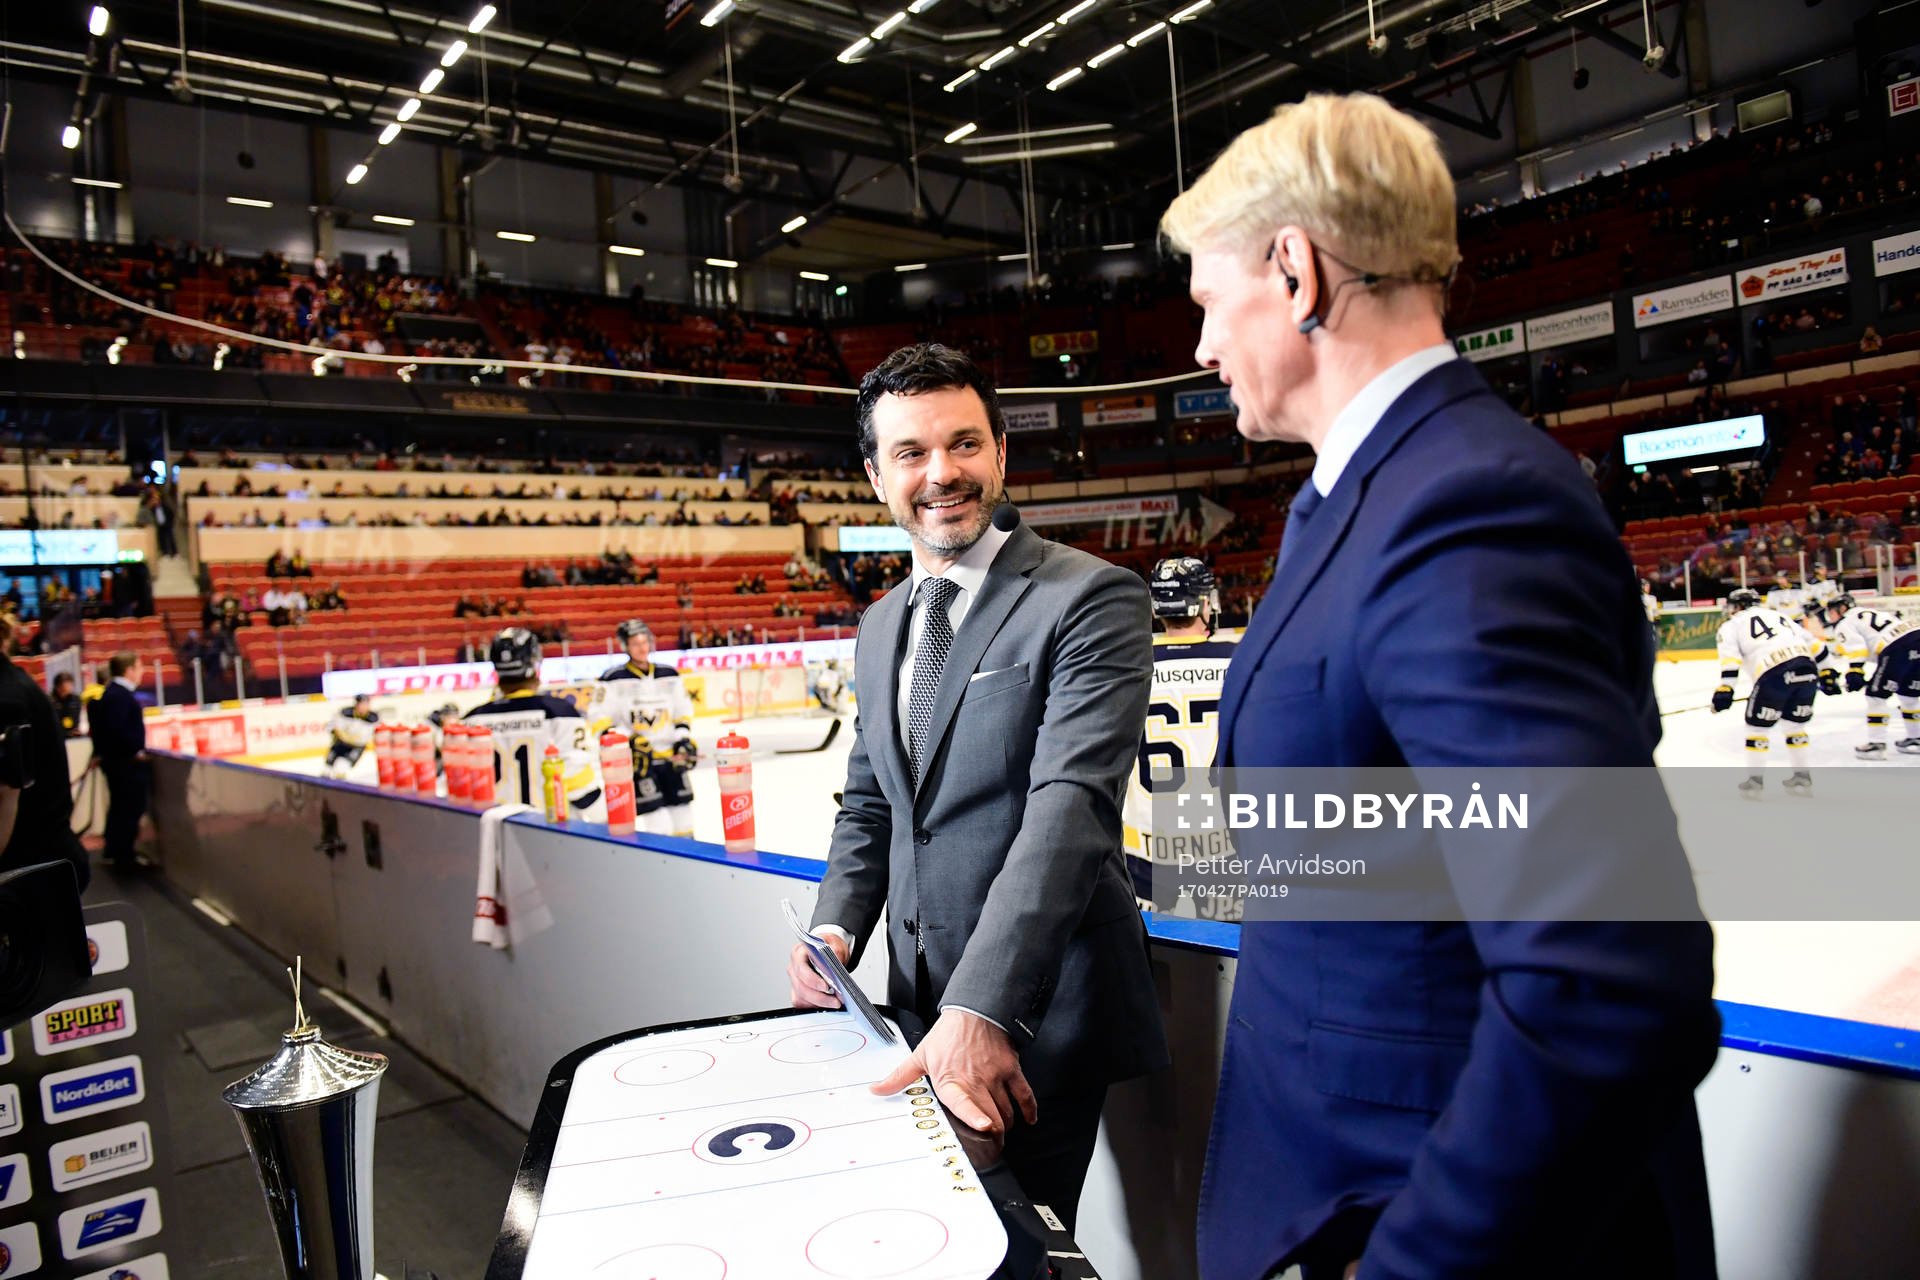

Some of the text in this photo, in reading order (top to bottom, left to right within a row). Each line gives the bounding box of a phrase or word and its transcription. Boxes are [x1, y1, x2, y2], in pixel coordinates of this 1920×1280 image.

[47, 1001, 118, 1034] SPORT
[56, 1077, 131, 1104] NordicBet
[90, 1141, 138, 1161] BEIJER
